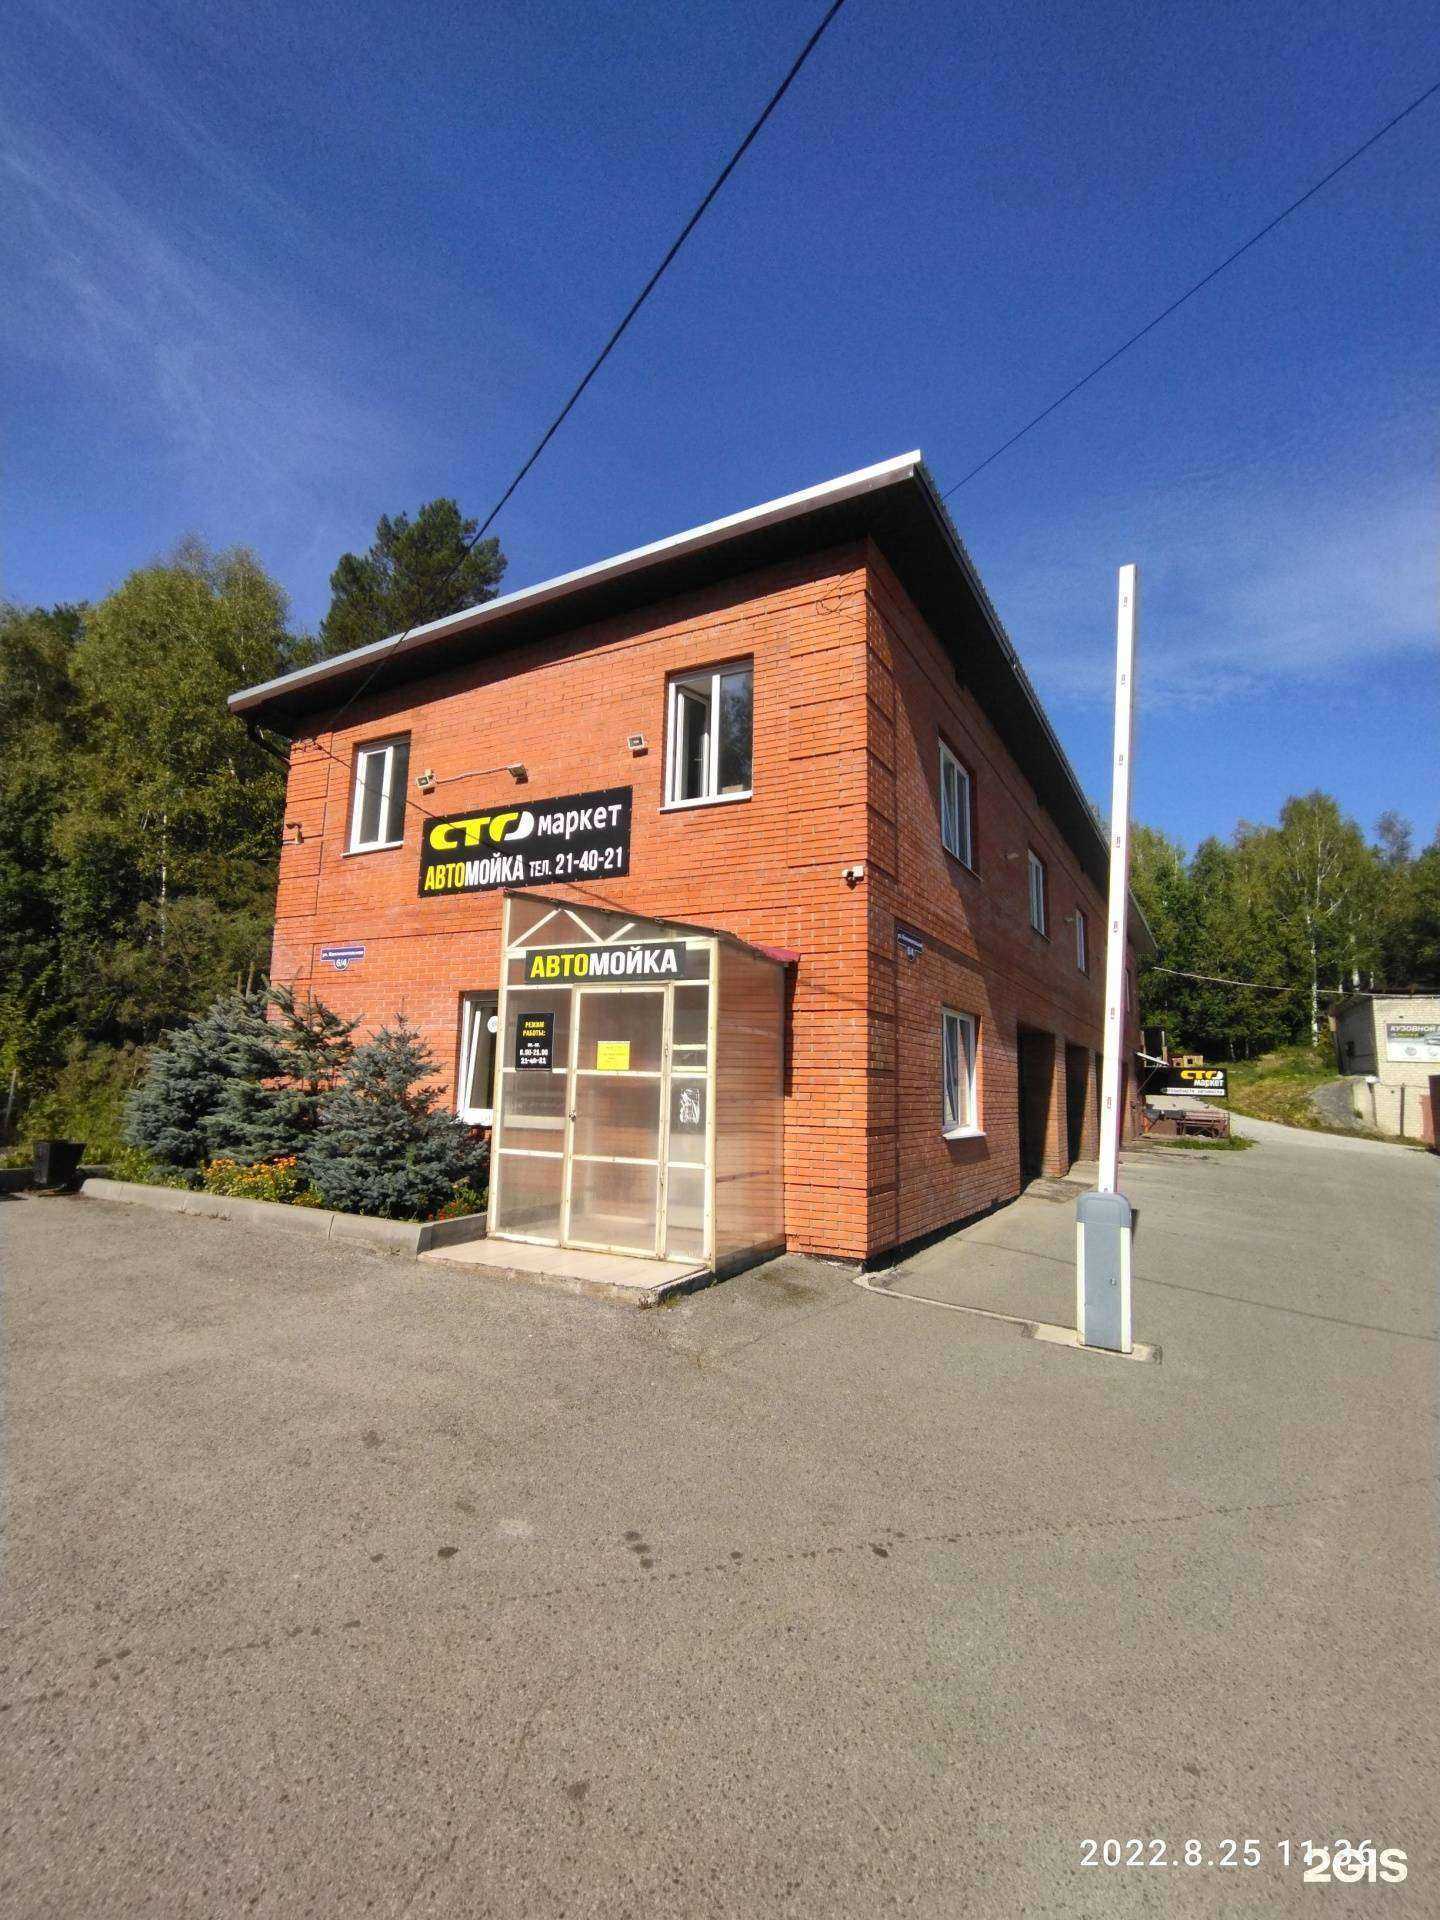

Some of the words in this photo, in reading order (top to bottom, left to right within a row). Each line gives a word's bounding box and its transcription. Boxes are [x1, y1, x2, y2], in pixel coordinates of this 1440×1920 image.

[429, 811, 535, 851] СТО
[537, 803, 622, 840] маркет
[424, 851, 525, 891] АВТОМОЙКА
[555, 846, 623, 875] 21-40-21
[530, 946, 678, 979] АВТОМОЙКА
[1181, 1070, 1224, 1080] СТО
